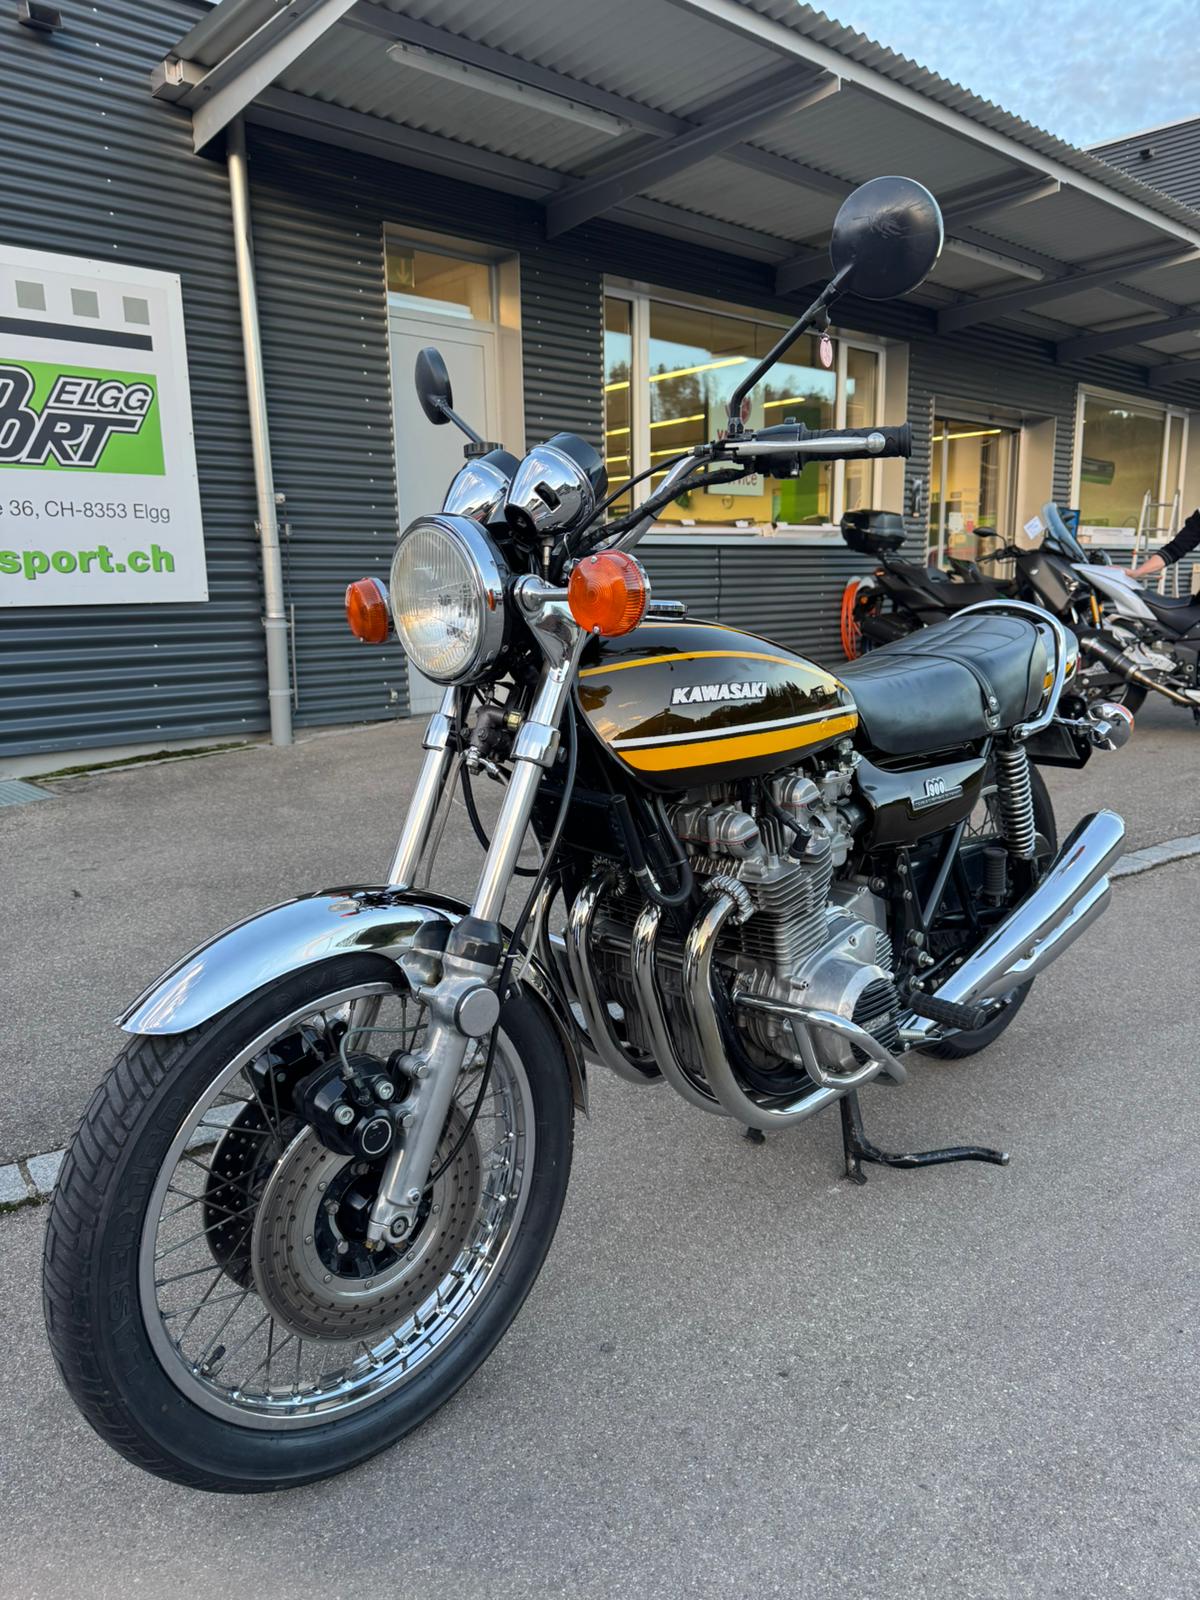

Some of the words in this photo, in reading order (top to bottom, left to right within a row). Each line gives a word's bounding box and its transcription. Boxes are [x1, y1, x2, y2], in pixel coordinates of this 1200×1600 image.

[49, 376, 153, 414] ELGG
[9, 499, 40, 520] 36,
[44, 500, 128, 519] CH-8353
[133, 503, 171, 524] Elgg
[0, 543, 175, 580] sport.ch
[671, 681, 767, 705] KAWASAKI
[929, 781, 945, 797] 900
